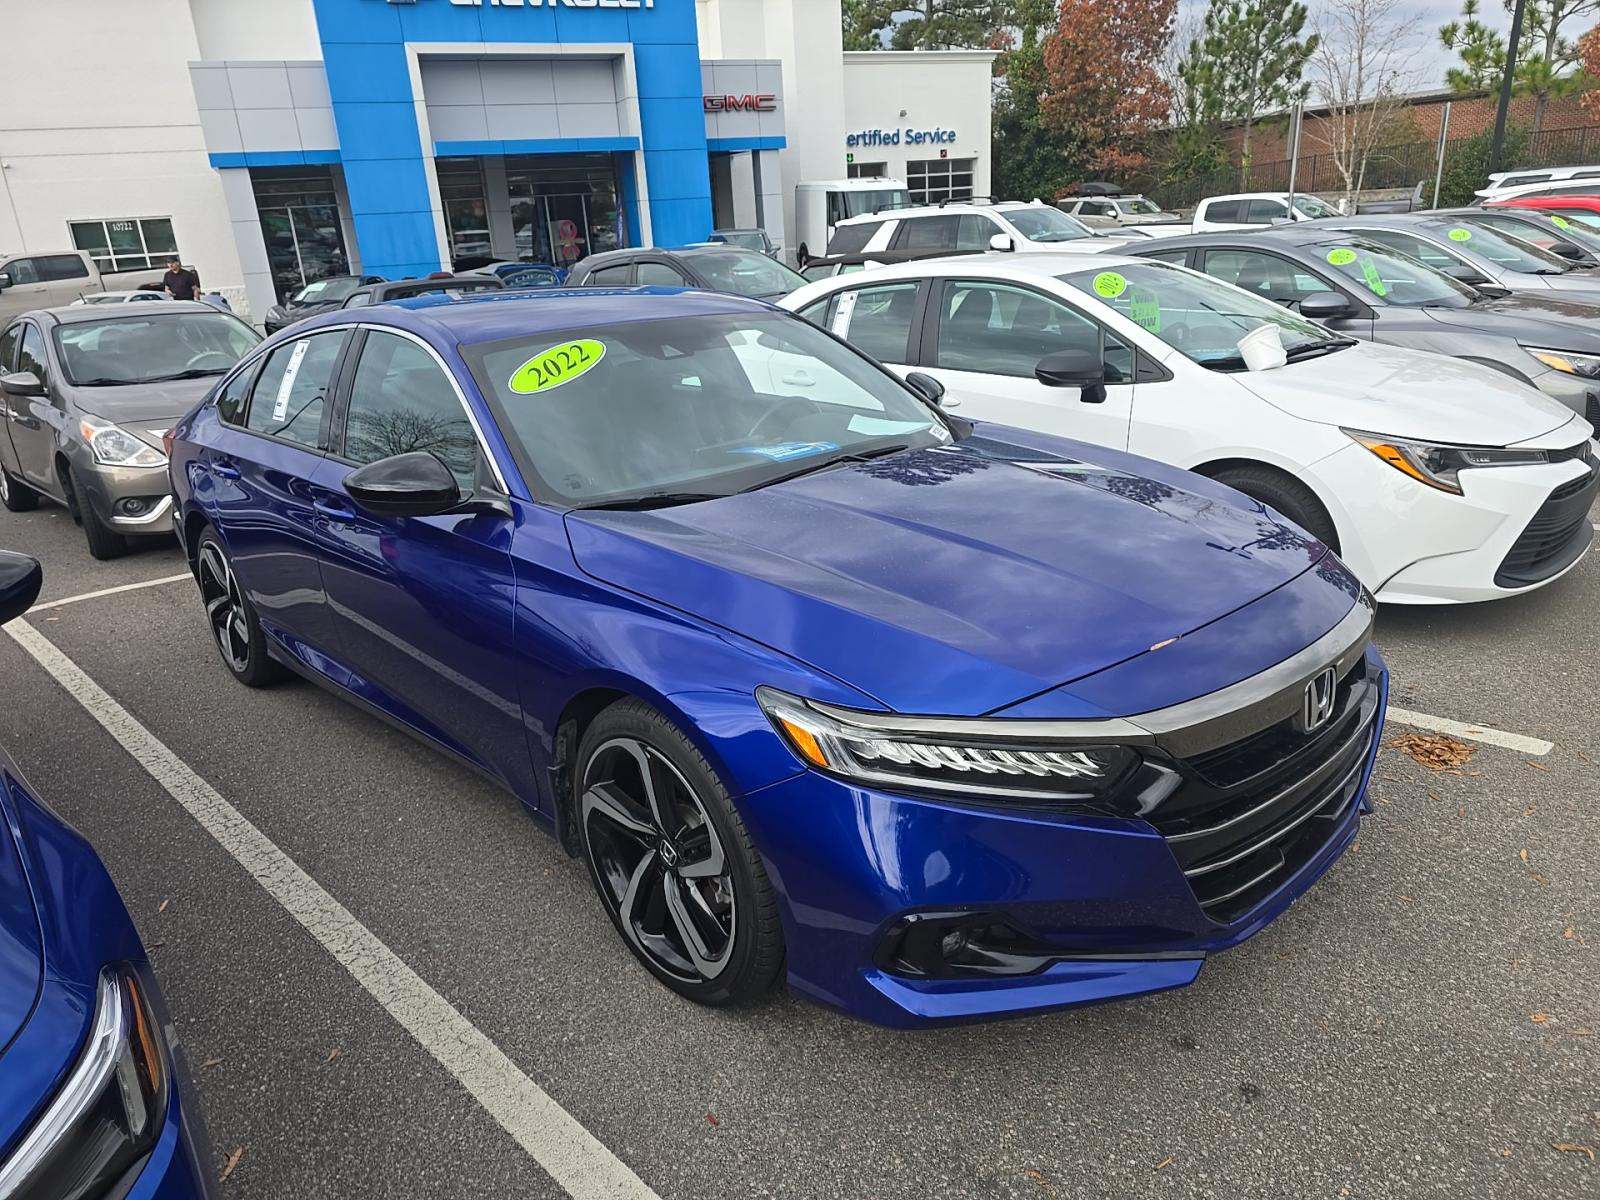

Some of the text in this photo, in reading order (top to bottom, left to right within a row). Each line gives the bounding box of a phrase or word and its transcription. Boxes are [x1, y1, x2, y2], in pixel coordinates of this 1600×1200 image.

[703, 95, 776, 112] GMC
[846, 127, 956, 146] ertified Service
[527, 345, 590, 387] 2022
